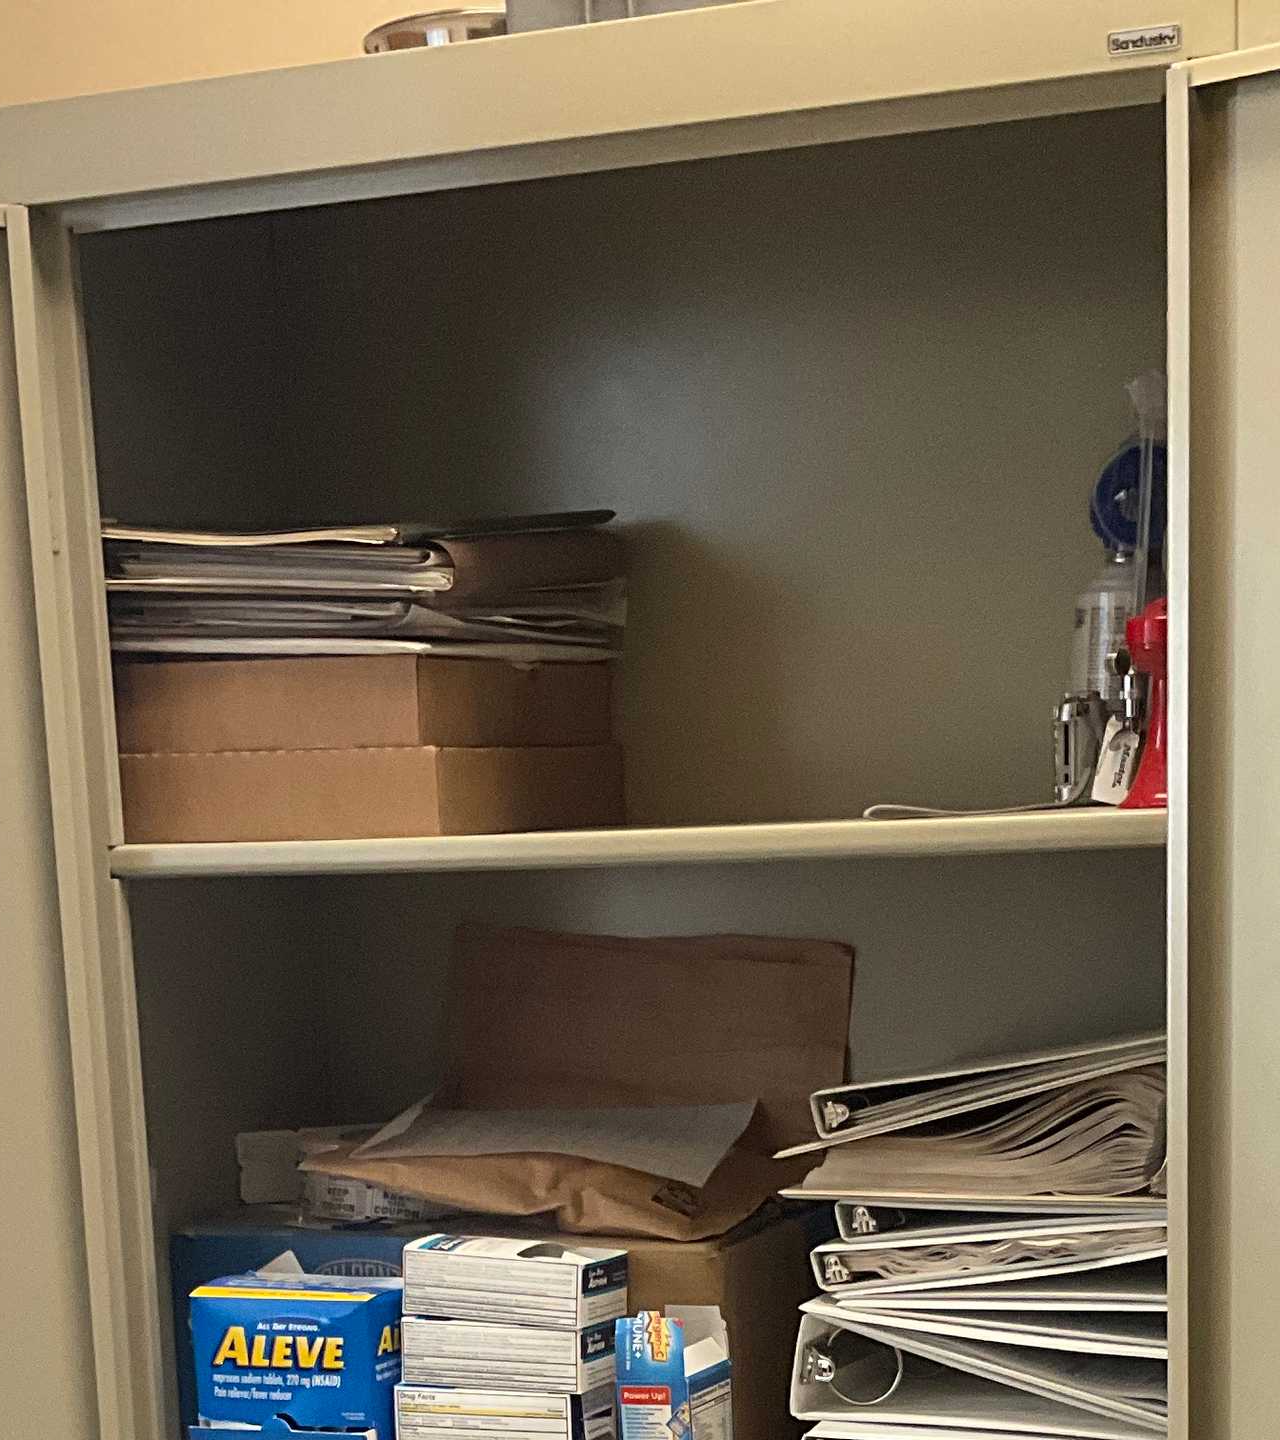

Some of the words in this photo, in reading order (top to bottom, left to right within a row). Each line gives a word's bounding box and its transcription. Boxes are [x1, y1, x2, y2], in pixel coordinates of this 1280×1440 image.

[1112, 33, 1175, 51] Sandusky
[213, 1326, 345, 1370] ALEVE
[623, 1391, 650, 1400] Power
[651, 1391, 667, 1401] Up!
